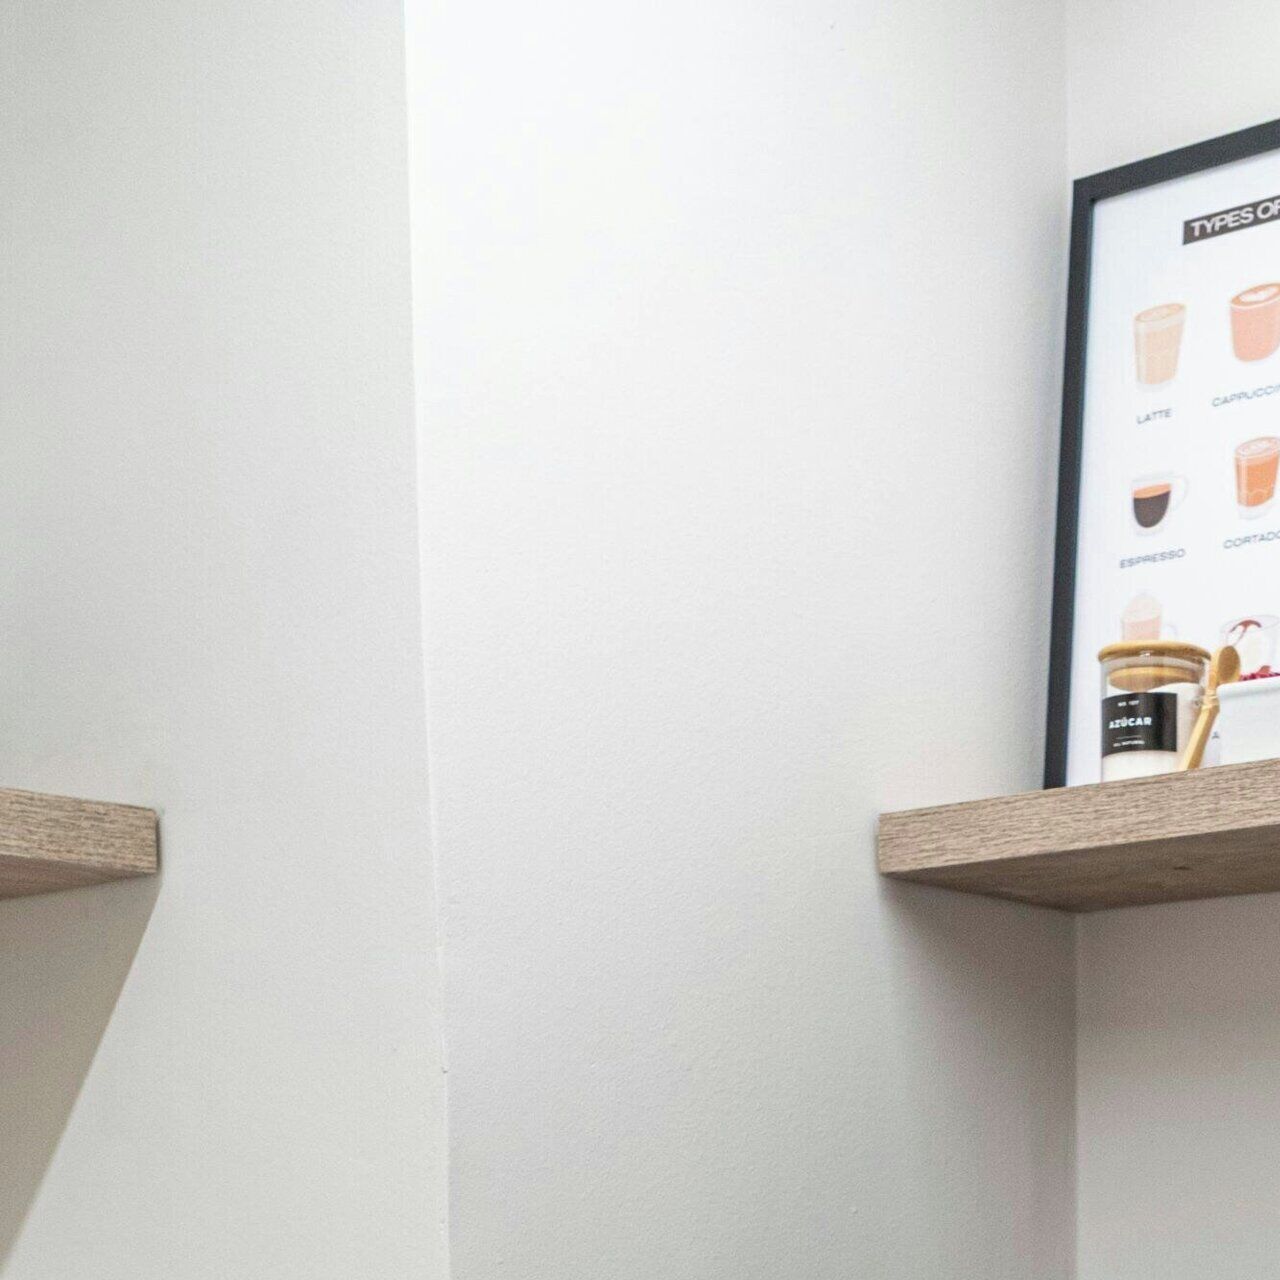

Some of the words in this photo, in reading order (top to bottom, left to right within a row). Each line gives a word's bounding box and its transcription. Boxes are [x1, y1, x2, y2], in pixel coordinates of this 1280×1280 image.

[1189, 206, 1254, 237] TYPES
[1136, 408, 1172, 425] LATTE
[1119, 548, 1187, 569] ESPRESSO
